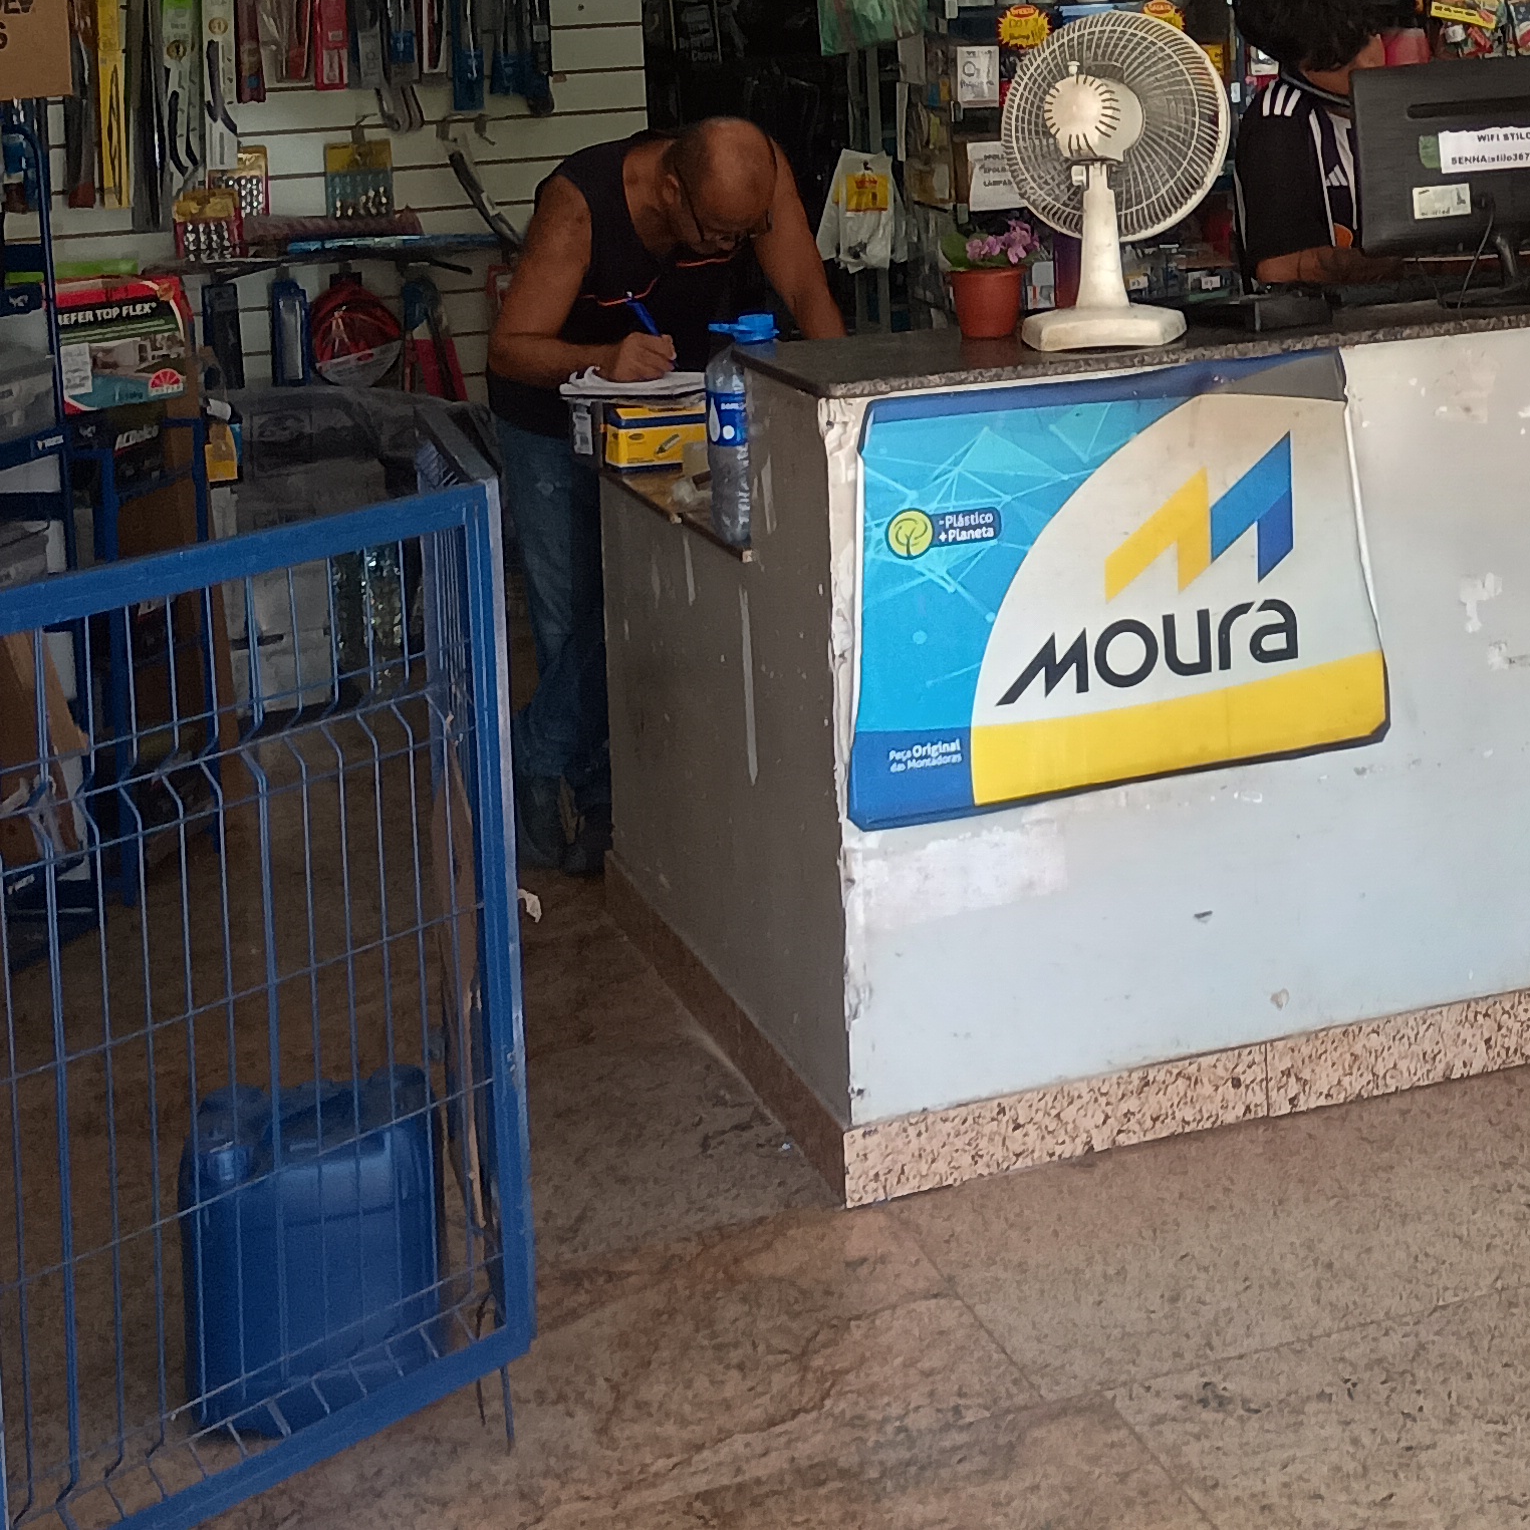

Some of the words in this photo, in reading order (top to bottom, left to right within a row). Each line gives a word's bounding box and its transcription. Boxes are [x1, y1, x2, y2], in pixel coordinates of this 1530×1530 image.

[1477, 133, 1500, 143] WIFI
[95, 306, 120, 322] TOP
[911, 738, 962, 760] Original
[890, 760, 906, 774] das
[906, 753, 963, 771] Montadoras
